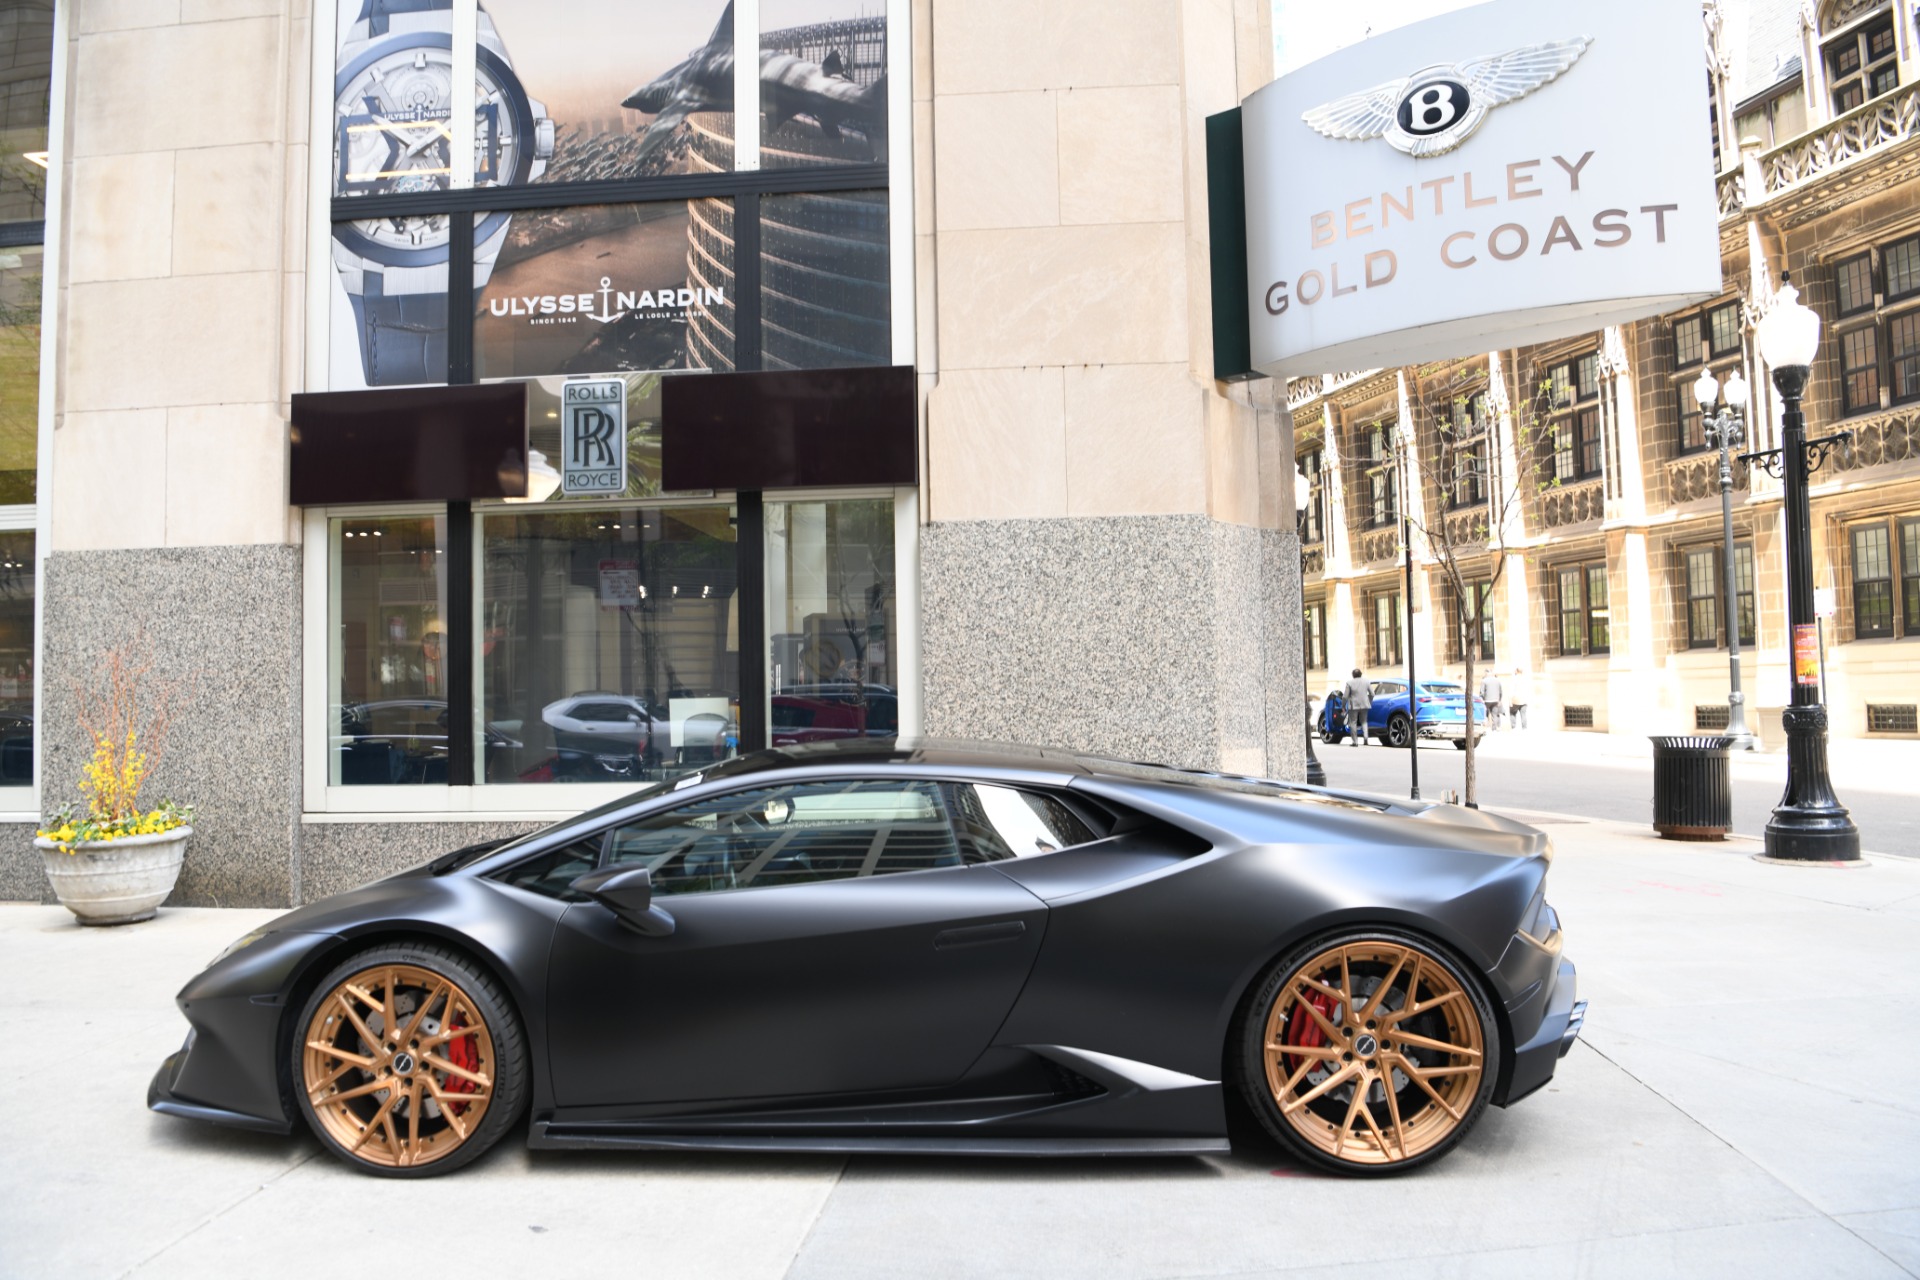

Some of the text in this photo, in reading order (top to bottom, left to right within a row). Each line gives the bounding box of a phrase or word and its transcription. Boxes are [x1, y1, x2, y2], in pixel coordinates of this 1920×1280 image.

[423, 109, 450, 118] NARDI
[1408, 84, 1455, 130] B
[1311, 151, 1595, 250] BENTLEY
[1265, 204, 1678, 316] GOLD COAST
[490, 286, 724, 317] ULYSSE NARDIN
[568, 386, 618, 400] ROLLS
[568, 473, 618, 487] ROYCE
